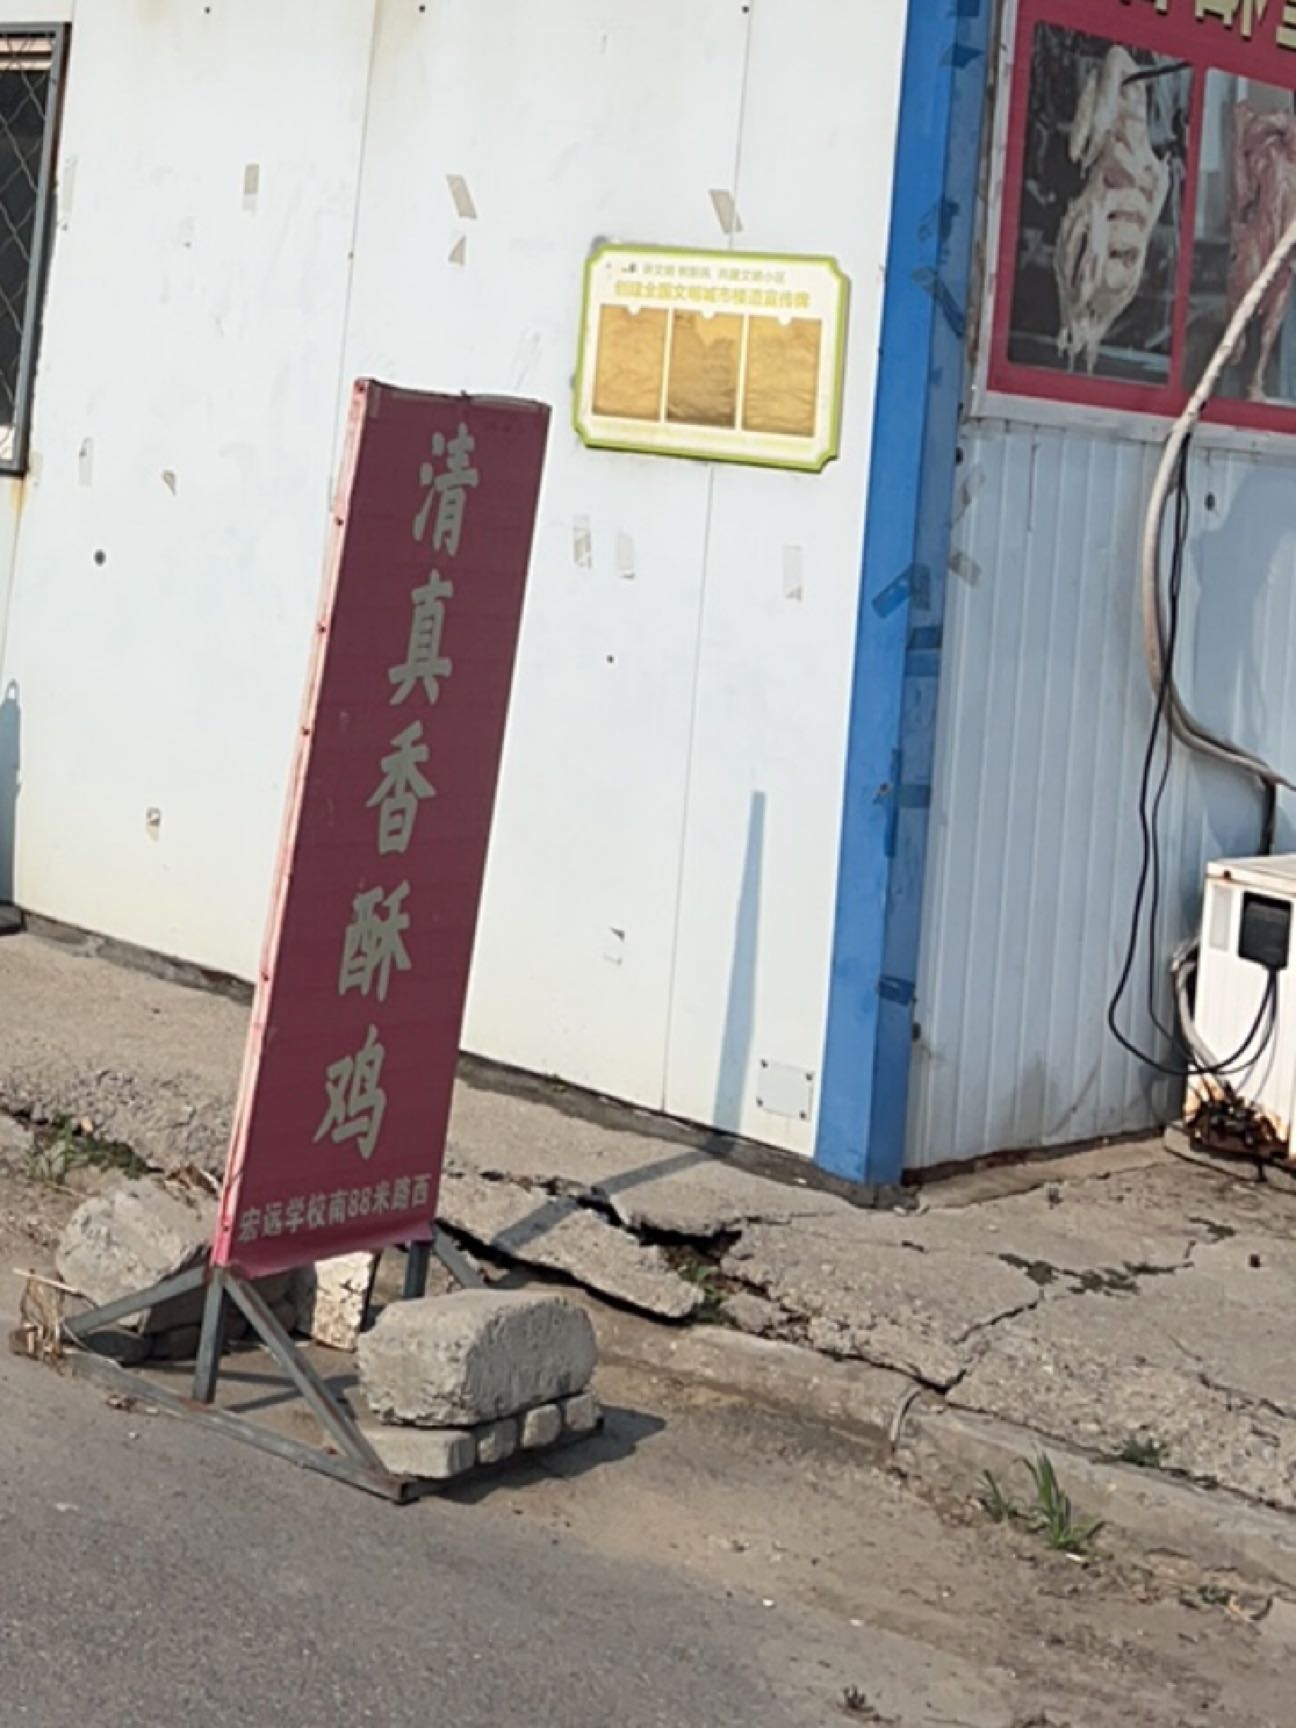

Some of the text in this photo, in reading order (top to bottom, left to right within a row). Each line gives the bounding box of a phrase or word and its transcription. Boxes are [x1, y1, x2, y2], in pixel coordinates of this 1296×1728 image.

[312, 422, 480, 1161] 清真香酥鸡
